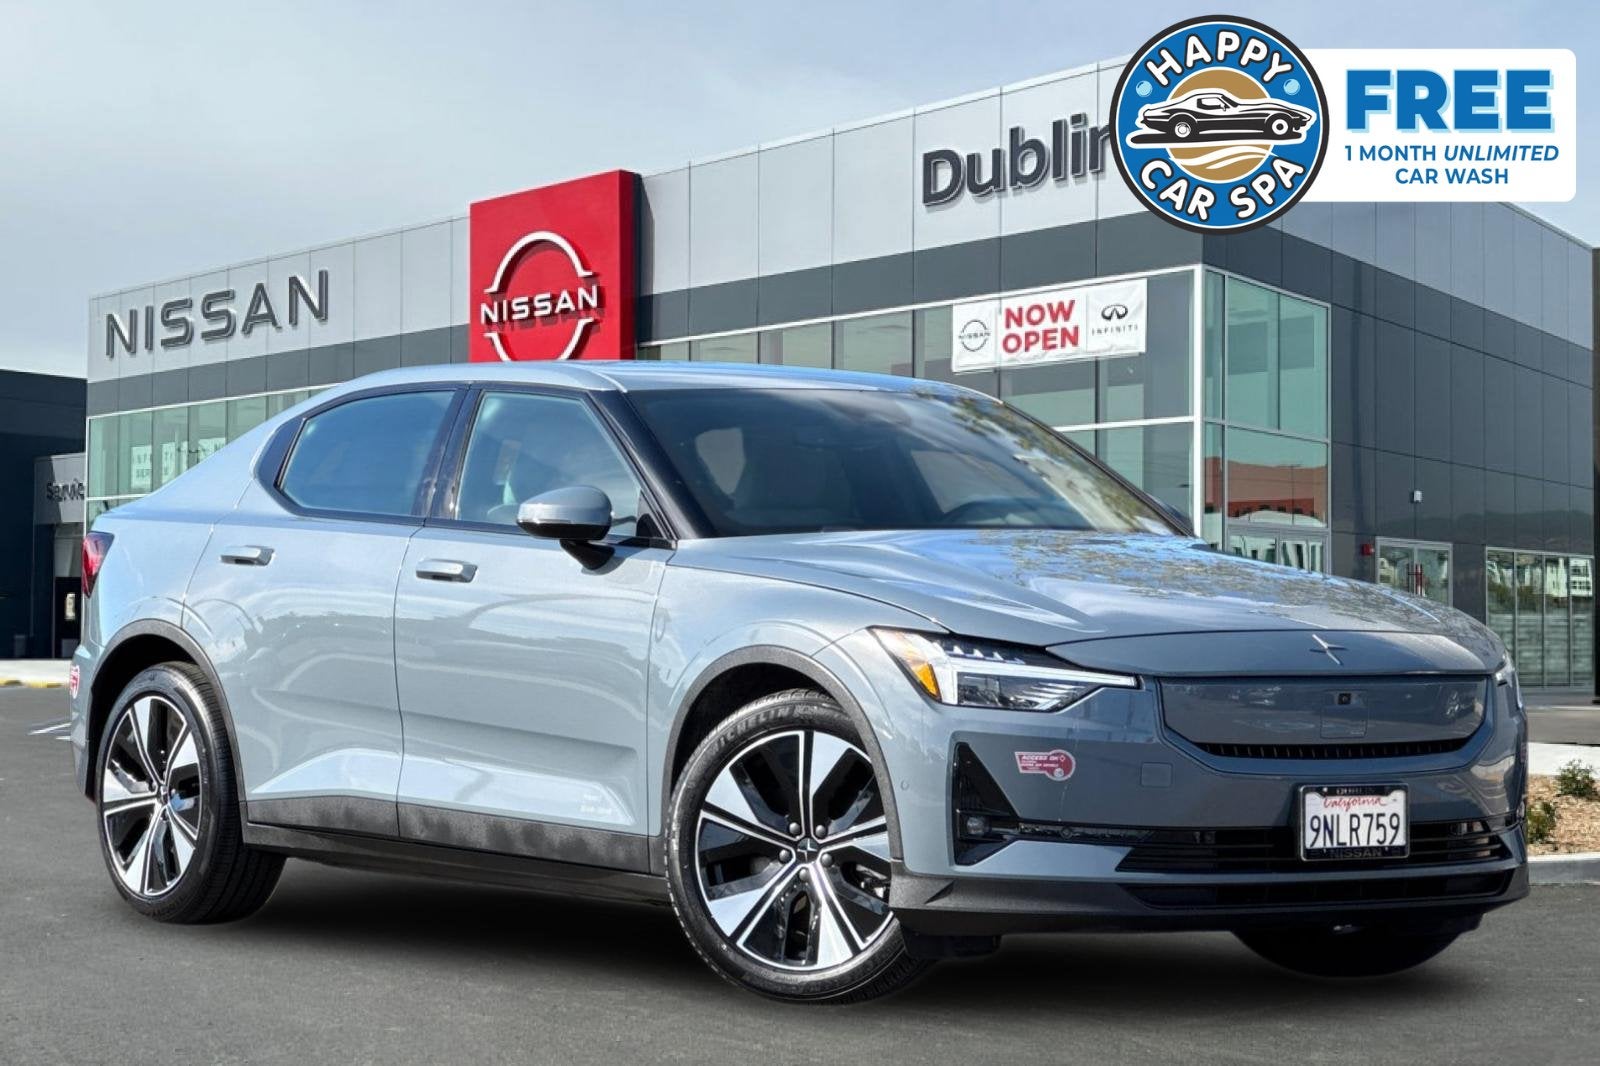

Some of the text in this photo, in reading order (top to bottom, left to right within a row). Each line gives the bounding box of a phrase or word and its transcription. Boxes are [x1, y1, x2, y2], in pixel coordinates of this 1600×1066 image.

[105, 269, 329, 358] NISSAN
[480, 286, 598, 324] NISSAN
[1005, 299, 1075, 329] NOW
[1002, 325, 1080, 354] OPEN
[1091, 323, 1138, 336] INFINITI
[1323, 796, 1387, 812] California
[1309, 812, 1400, 848] 9NLR759
